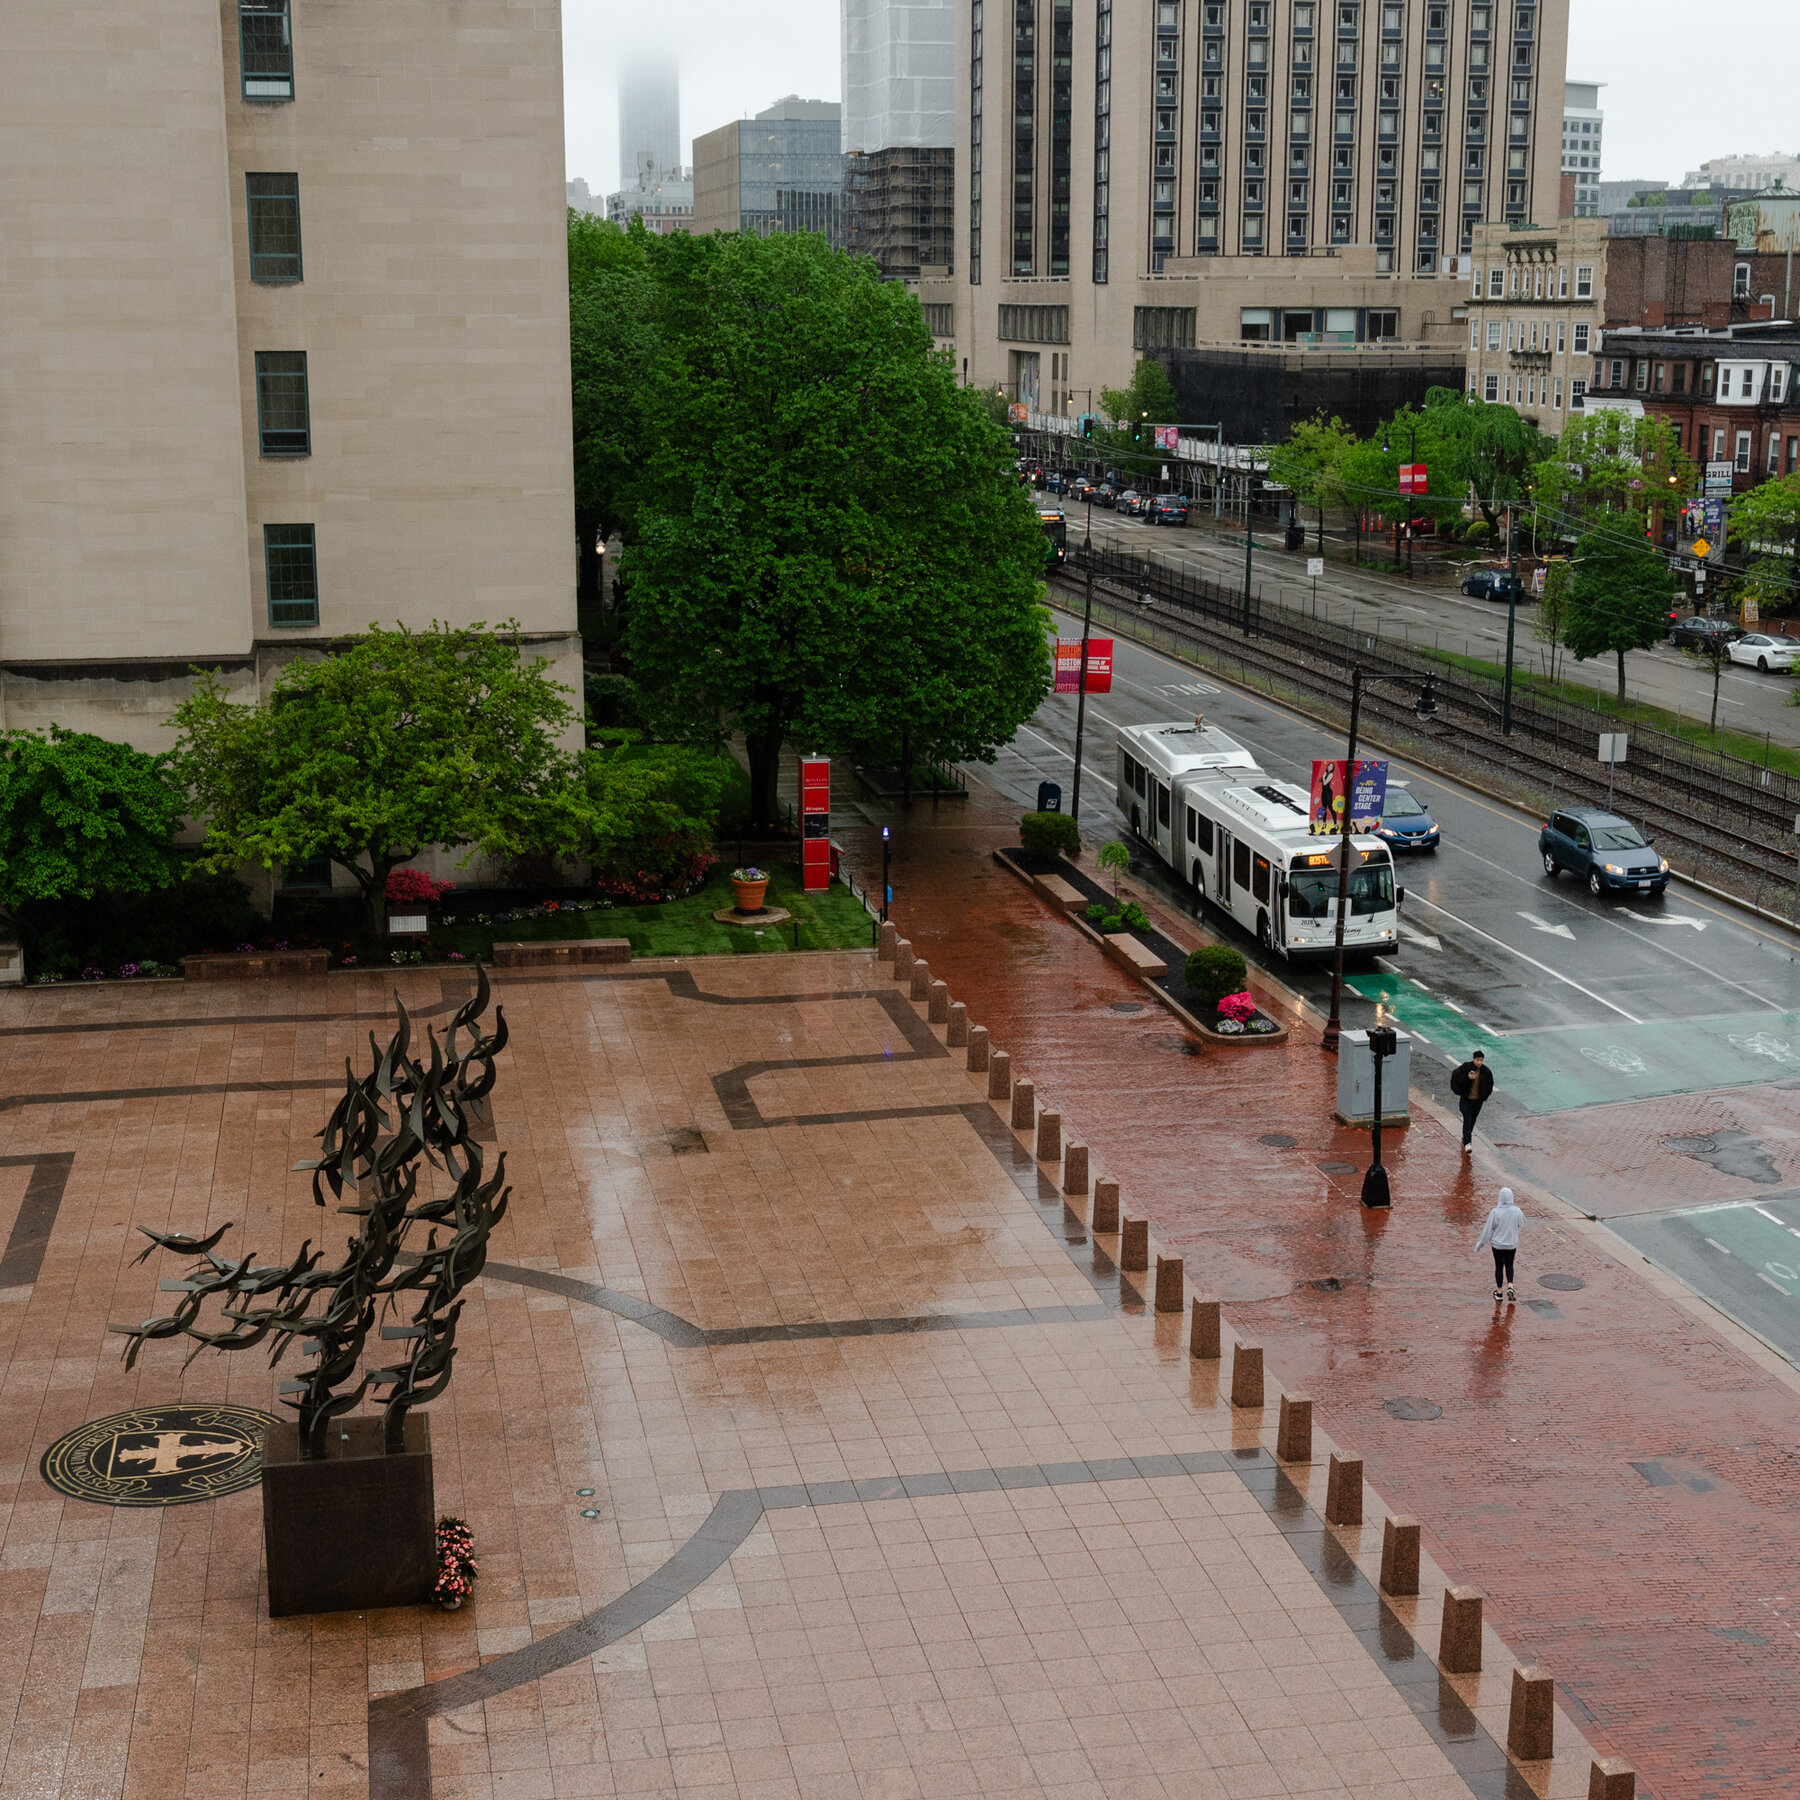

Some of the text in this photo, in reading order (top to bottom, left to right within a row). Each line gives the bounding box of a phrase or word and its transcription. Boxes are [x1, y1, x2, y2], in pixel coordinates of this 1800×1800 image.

[1058, 658, 1081, 666] BOSTON
[1153, 684, 1221, 696] ONLY
[1355, 787, 1373, 795] BEING
[1354, 802, 1372, 810] STAGE
[71, 1423, 129, 1465] UNIVERSITY
[71, 1465, 121, 1491] BOSTON
